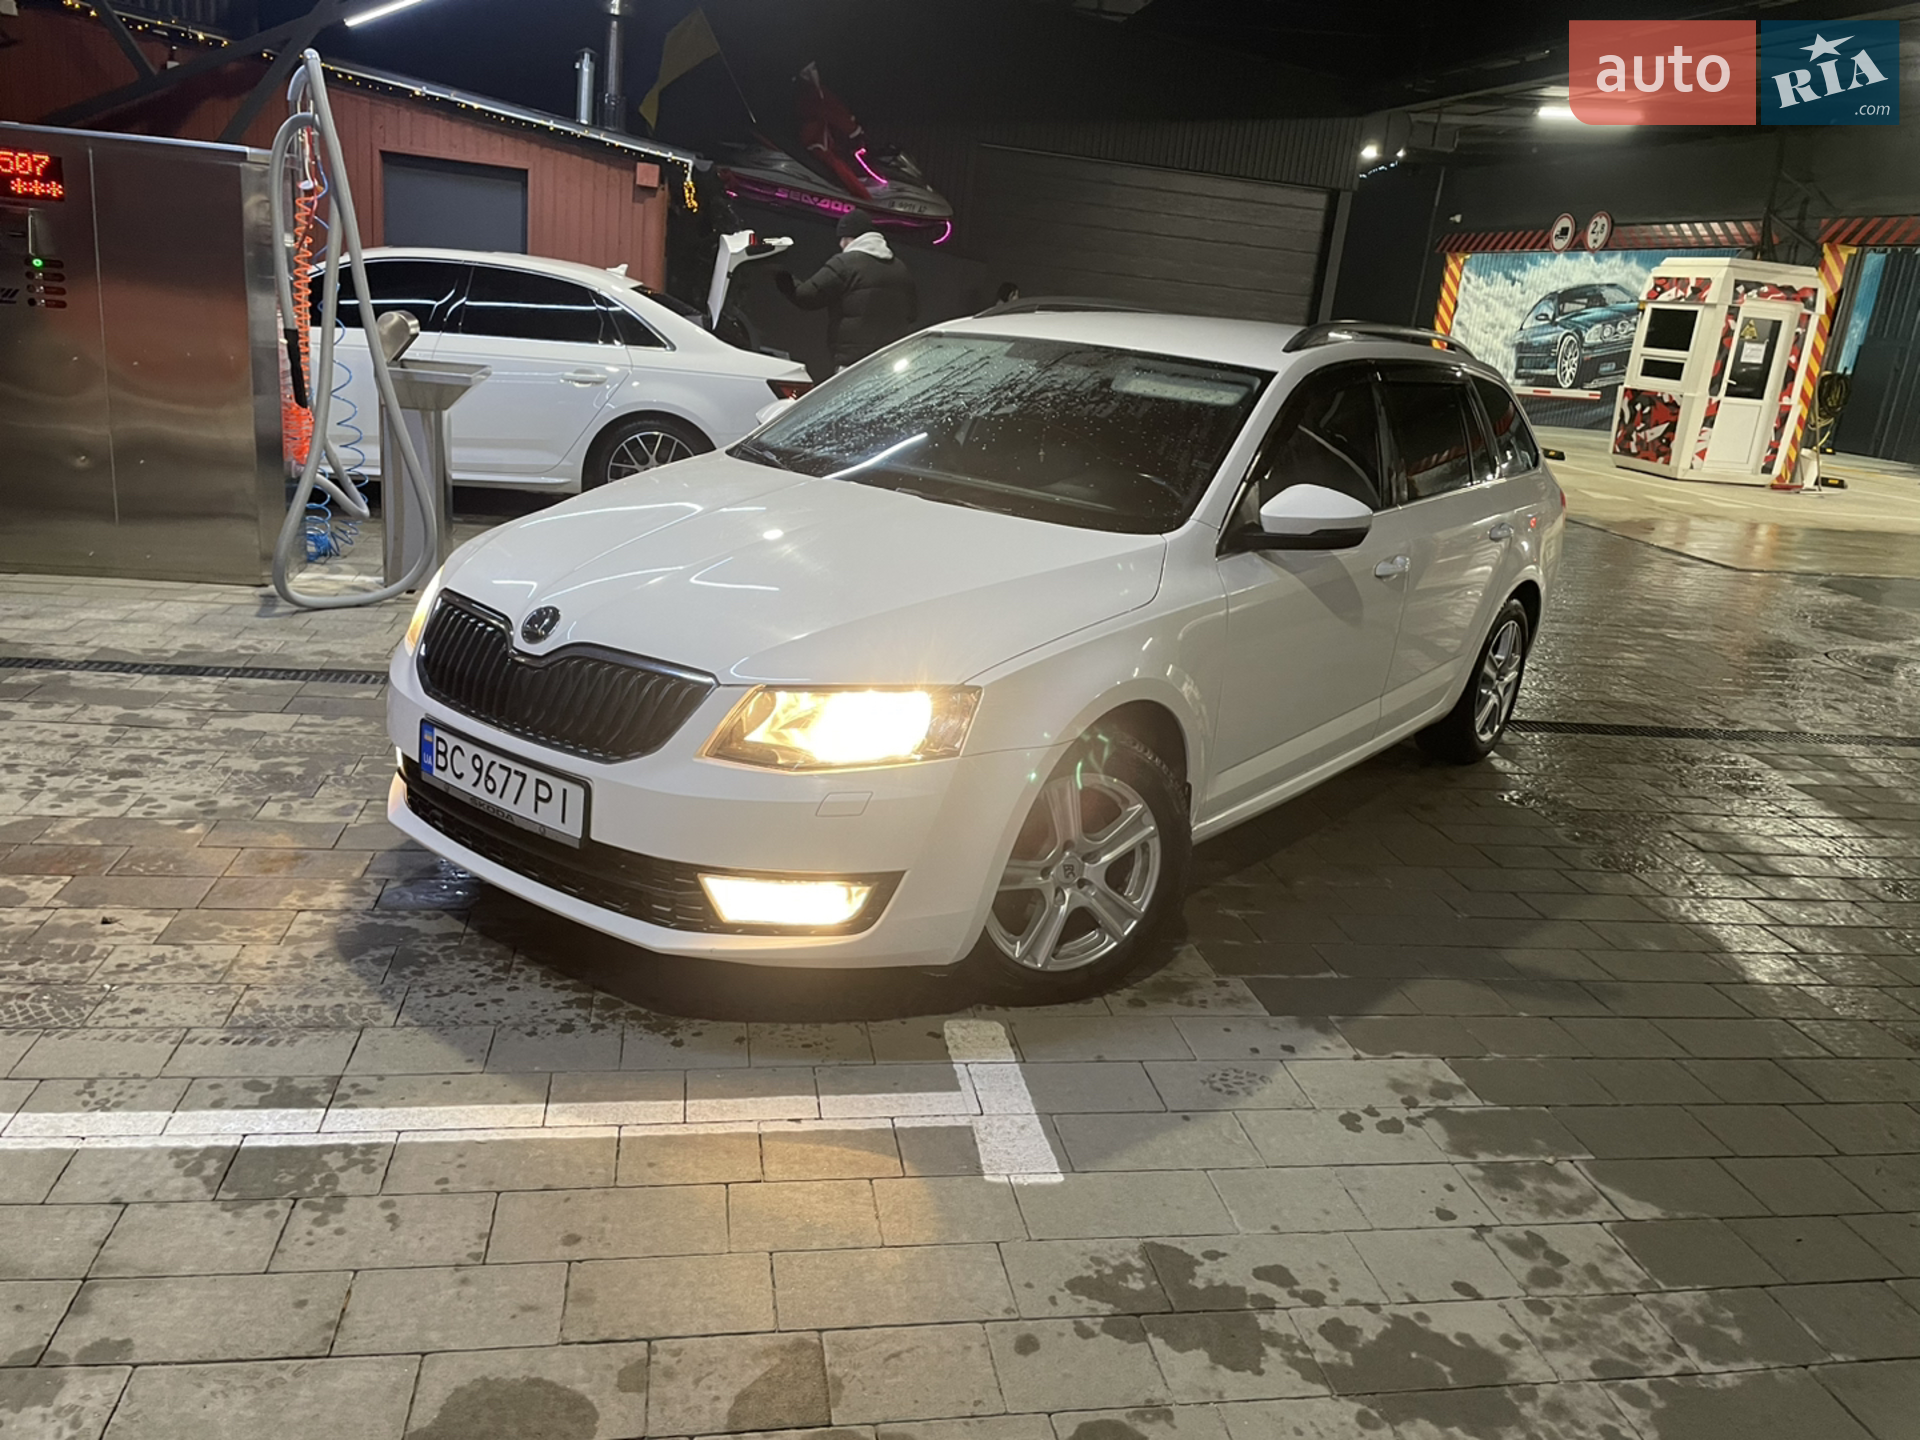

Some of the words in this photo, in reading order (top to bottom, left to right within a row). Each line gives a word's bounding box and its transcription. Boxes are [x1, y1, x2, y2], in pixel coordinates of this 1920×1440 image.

[423, 752, 433, 766] UA
[435, 735, 465, 780] BC
[471, 753, 527, 805] 9677
[534, 778, 567, 824] PI
